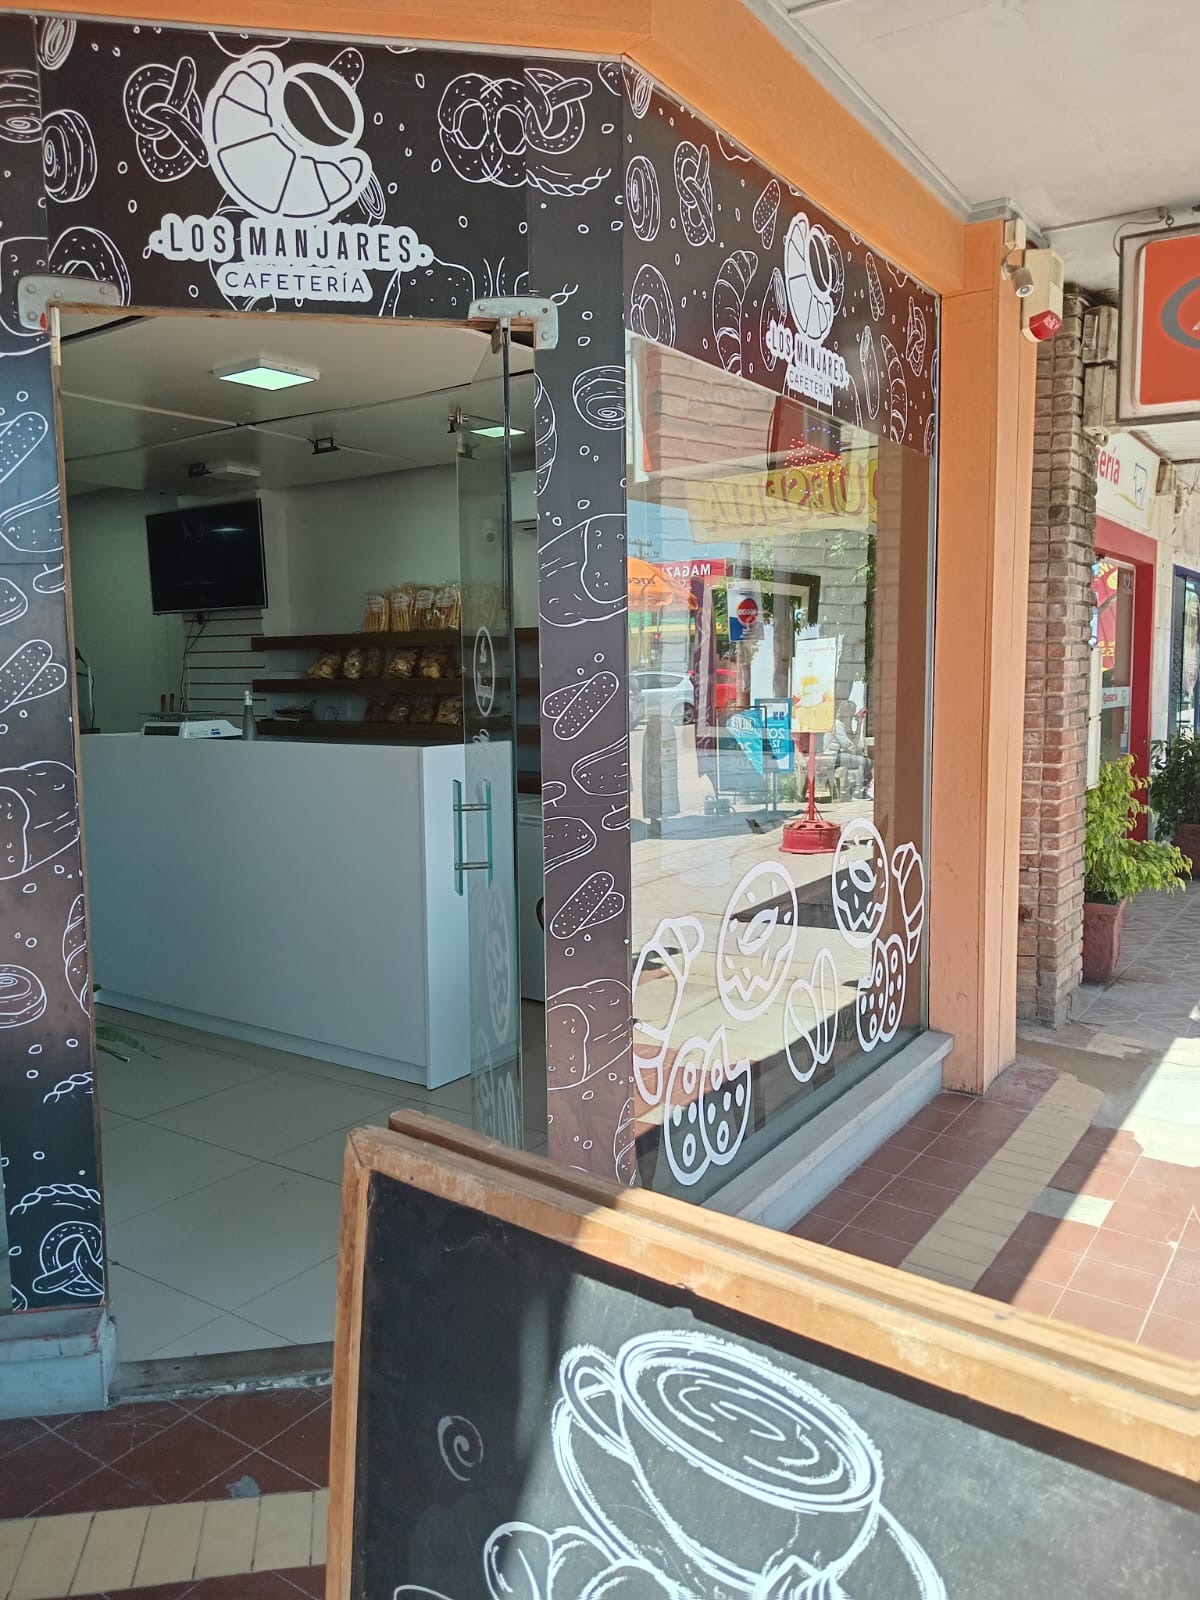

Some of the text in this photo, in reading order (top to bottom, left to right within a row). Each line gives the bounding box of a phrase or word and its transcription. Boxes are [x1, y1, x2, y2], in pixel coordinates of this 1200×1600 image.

[169, 221, 412, 264] LOS MANJARES
[224, 271, 366, 295] CAFETERÍA
[772, 327, 845, 383] LOS MANJARES
[1096, 446, 1121, 485] ería
